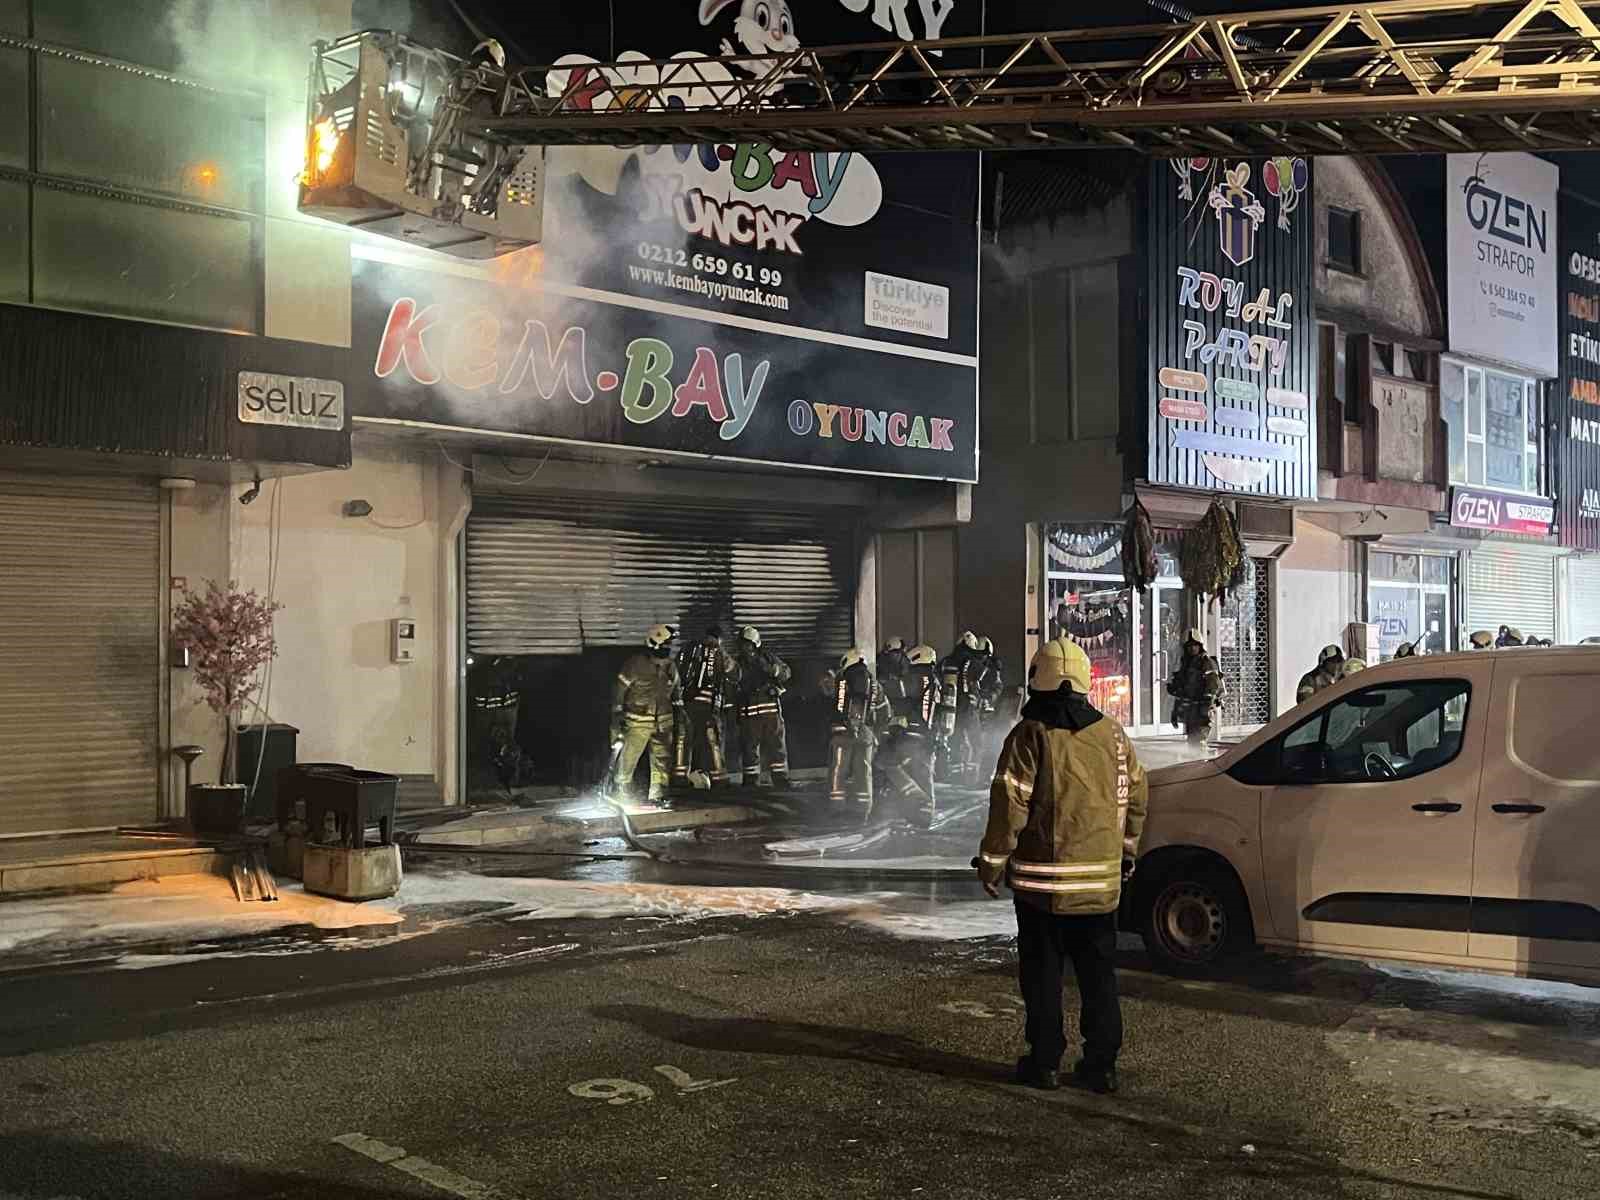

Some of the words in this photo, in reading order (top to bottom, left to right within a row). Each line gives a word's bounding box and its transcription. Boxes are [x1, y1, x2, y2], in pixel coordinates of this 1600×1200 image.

[637, 242, 689, 267] 0212
[692, 253, 728, 276] 659
[732, 263, 754, 282] 61
[759, 268, 783, 287] 99
[1477, 240, 1535, 279] STRAFOR
[628, 264, 789, 311] www.kembayoyuncak.com
[872, 276, 944, 309] Türkiye
[872, 299, 917, 317] Discover
[872, 311, 889, 323] the
[1183, 320, 1288, 375] PARTY
[245, 381, 337, 418] seluz
[787, 399, 954, 452] OYUNCAK
